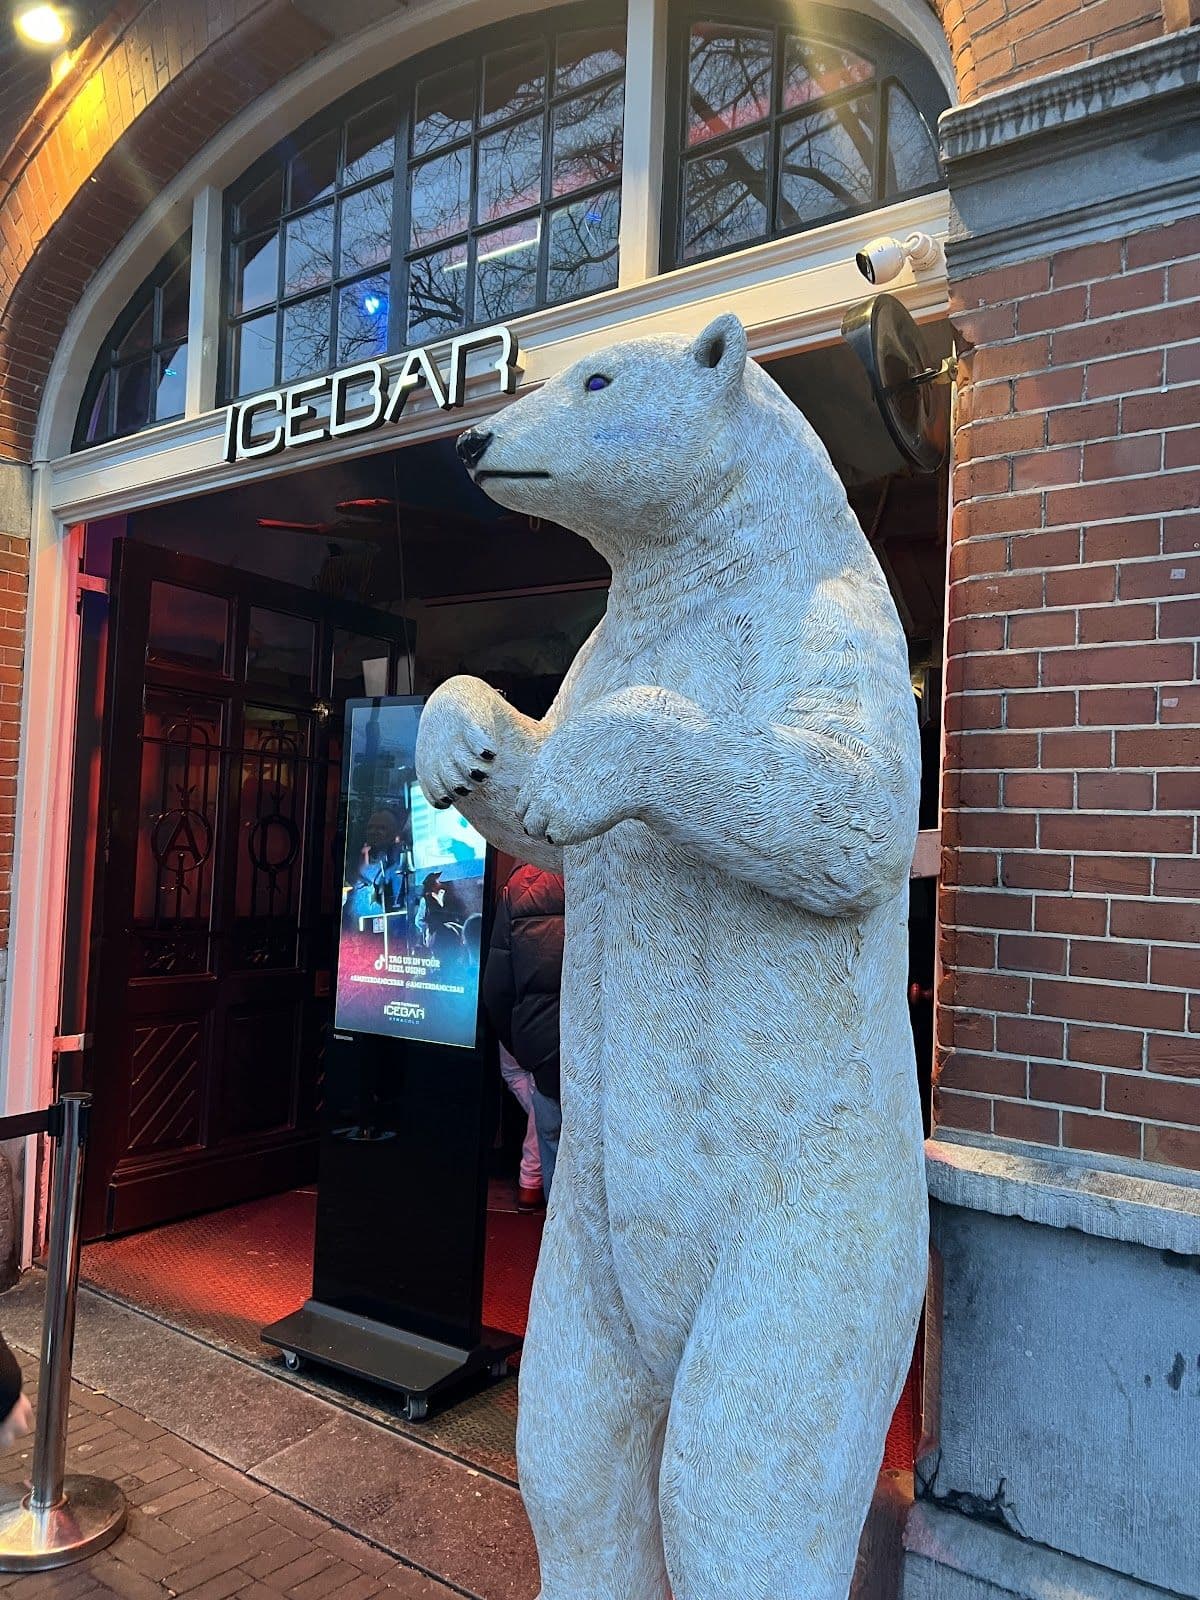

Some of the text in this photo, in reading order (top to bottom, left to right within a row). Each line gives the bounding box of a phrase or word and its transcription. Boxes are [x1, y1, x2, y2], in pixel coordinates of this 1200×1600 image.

[222, 325, 516, 462] ICEBAR
[421, 957, 441, 968] YOUR
[405, 966, 426, 976] USING
[383, 1004, 425, 1020] ICEBAR
